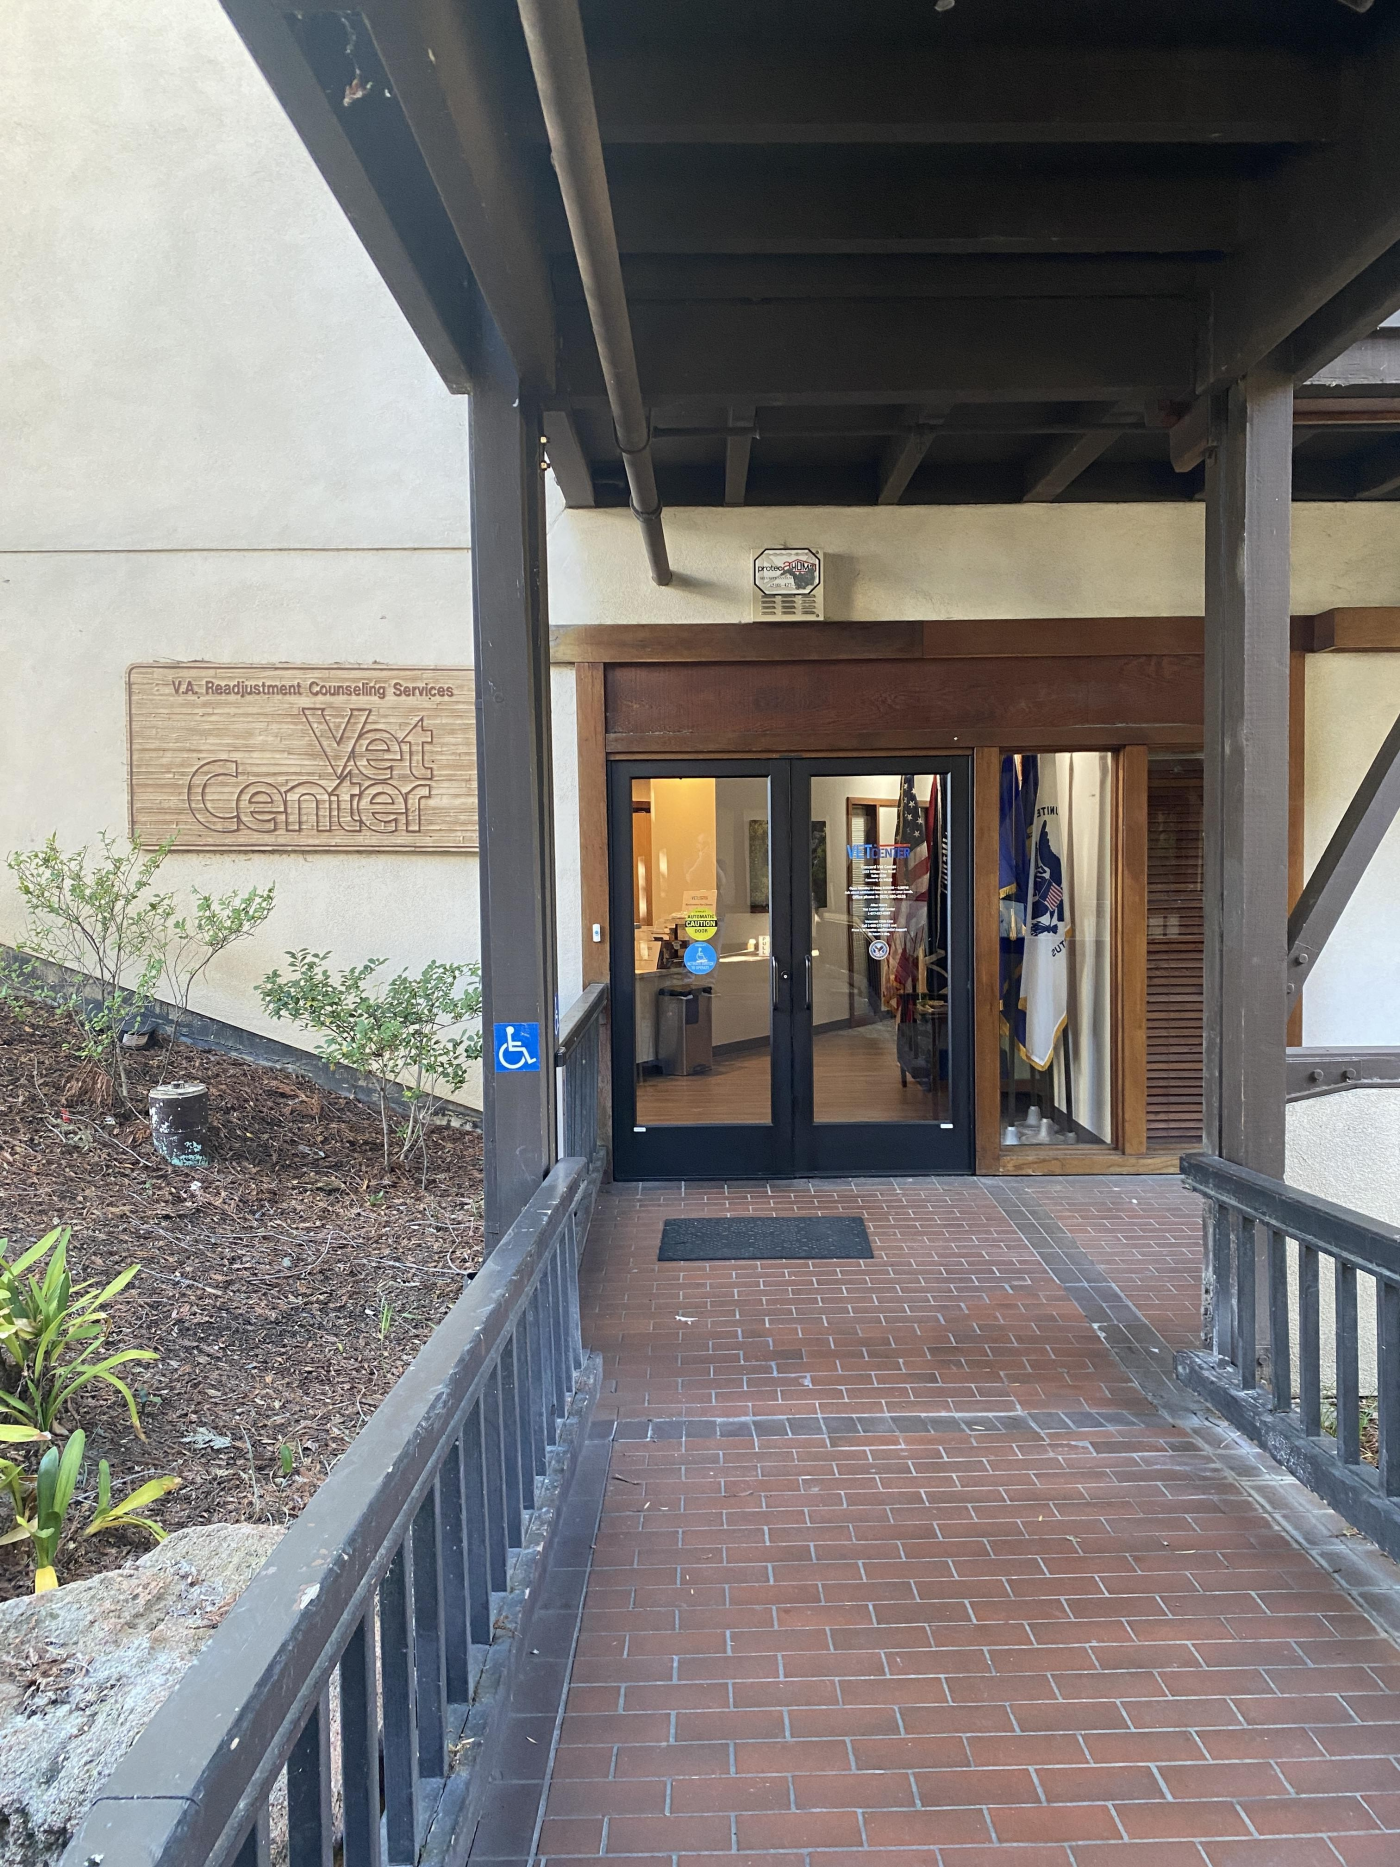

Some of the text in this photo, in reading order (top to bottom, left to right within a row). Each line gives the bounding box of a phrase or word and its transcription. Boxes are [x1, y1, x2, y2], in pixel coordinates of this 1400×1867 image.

[172, 680, 454, 699] V.A. Readjustment Counseling Services
[301, 707, 434, 780] Vet
[187, 759, 431, 833] Center
[846, 844, 911, 859] VET CENTER
